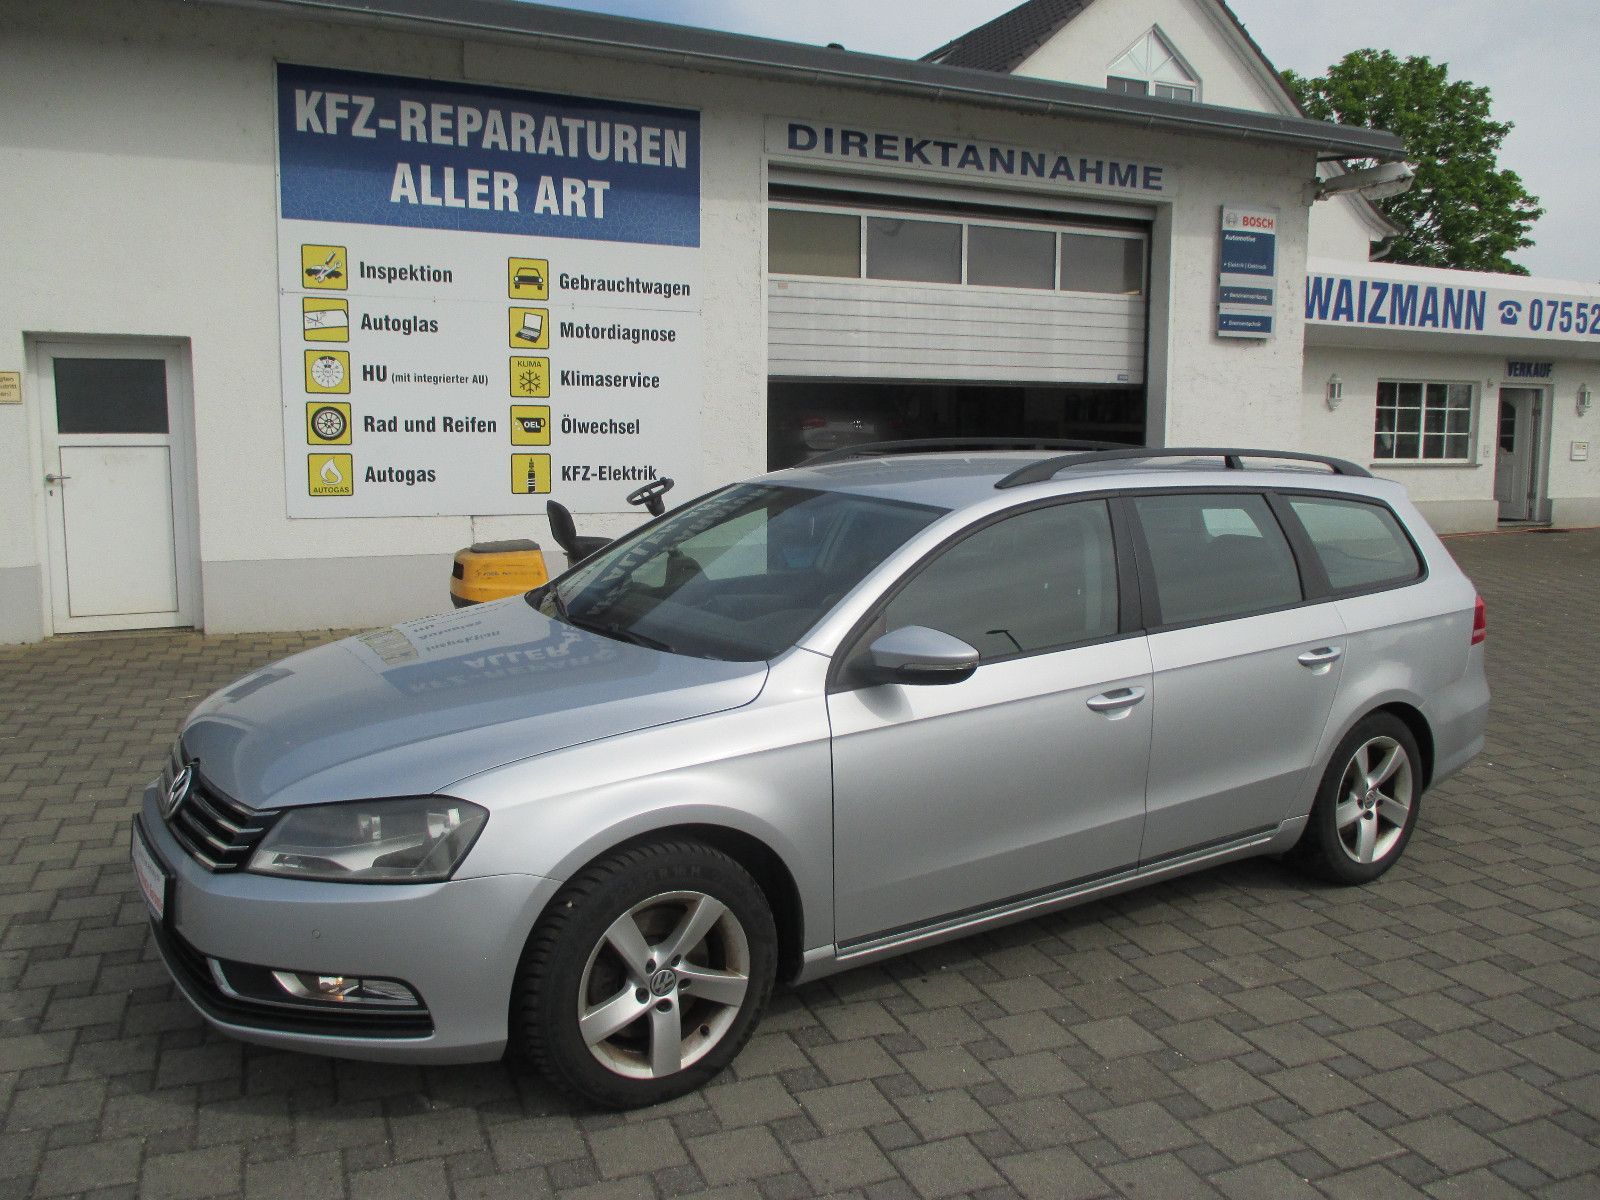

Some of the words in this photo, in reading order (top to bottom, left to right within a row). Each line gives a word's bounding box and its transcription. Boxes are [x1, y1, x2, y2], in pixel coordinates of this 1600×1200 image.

[295, 89, 687, 169] KFZ-REPARATUREN
[787, 122, 1163, 191] DIREKTANNAHME
[390, 162, 519, 213] ALLER
[533, 175, 610, 219] ART
[1242, 215, 1274, 229] BOSCH
[359, 261, 453, 283] Inspektion
[559, 272, 690, 298] Gebrauchtwagen
[1304, 275, 1486, 331] WAIZMANN
[1528, 298, 1600, 335] 07552
[361, 313, 439, 336] Autoglas
[560, 321, 676, 344] Motordiagnose
[517, 360, 542, 368] KLIMA
[1507, 361, 1553, 378] VERKAUF
[362, 364, 387, 382] HU
[391, 372, 411, 384] (mit
[413, 373, 469, 386] integrierter
[472, 374, 489, 387] AU)
[560, 370, 660, 388] Klimaservice
[364, 415, 398, 432] Rad
[404, 416, 436, 433] und
[443, 416, 497, 433] Reifen
[523, 420, 541, 429] OEL
[561, 414, 640, 435] Ölwechsel
[364, 466, 437, 486] Autogas
[561, 465, 658, 482] KFZ-Elektrik
[313, 486, 350, 494] AUTOGAS
